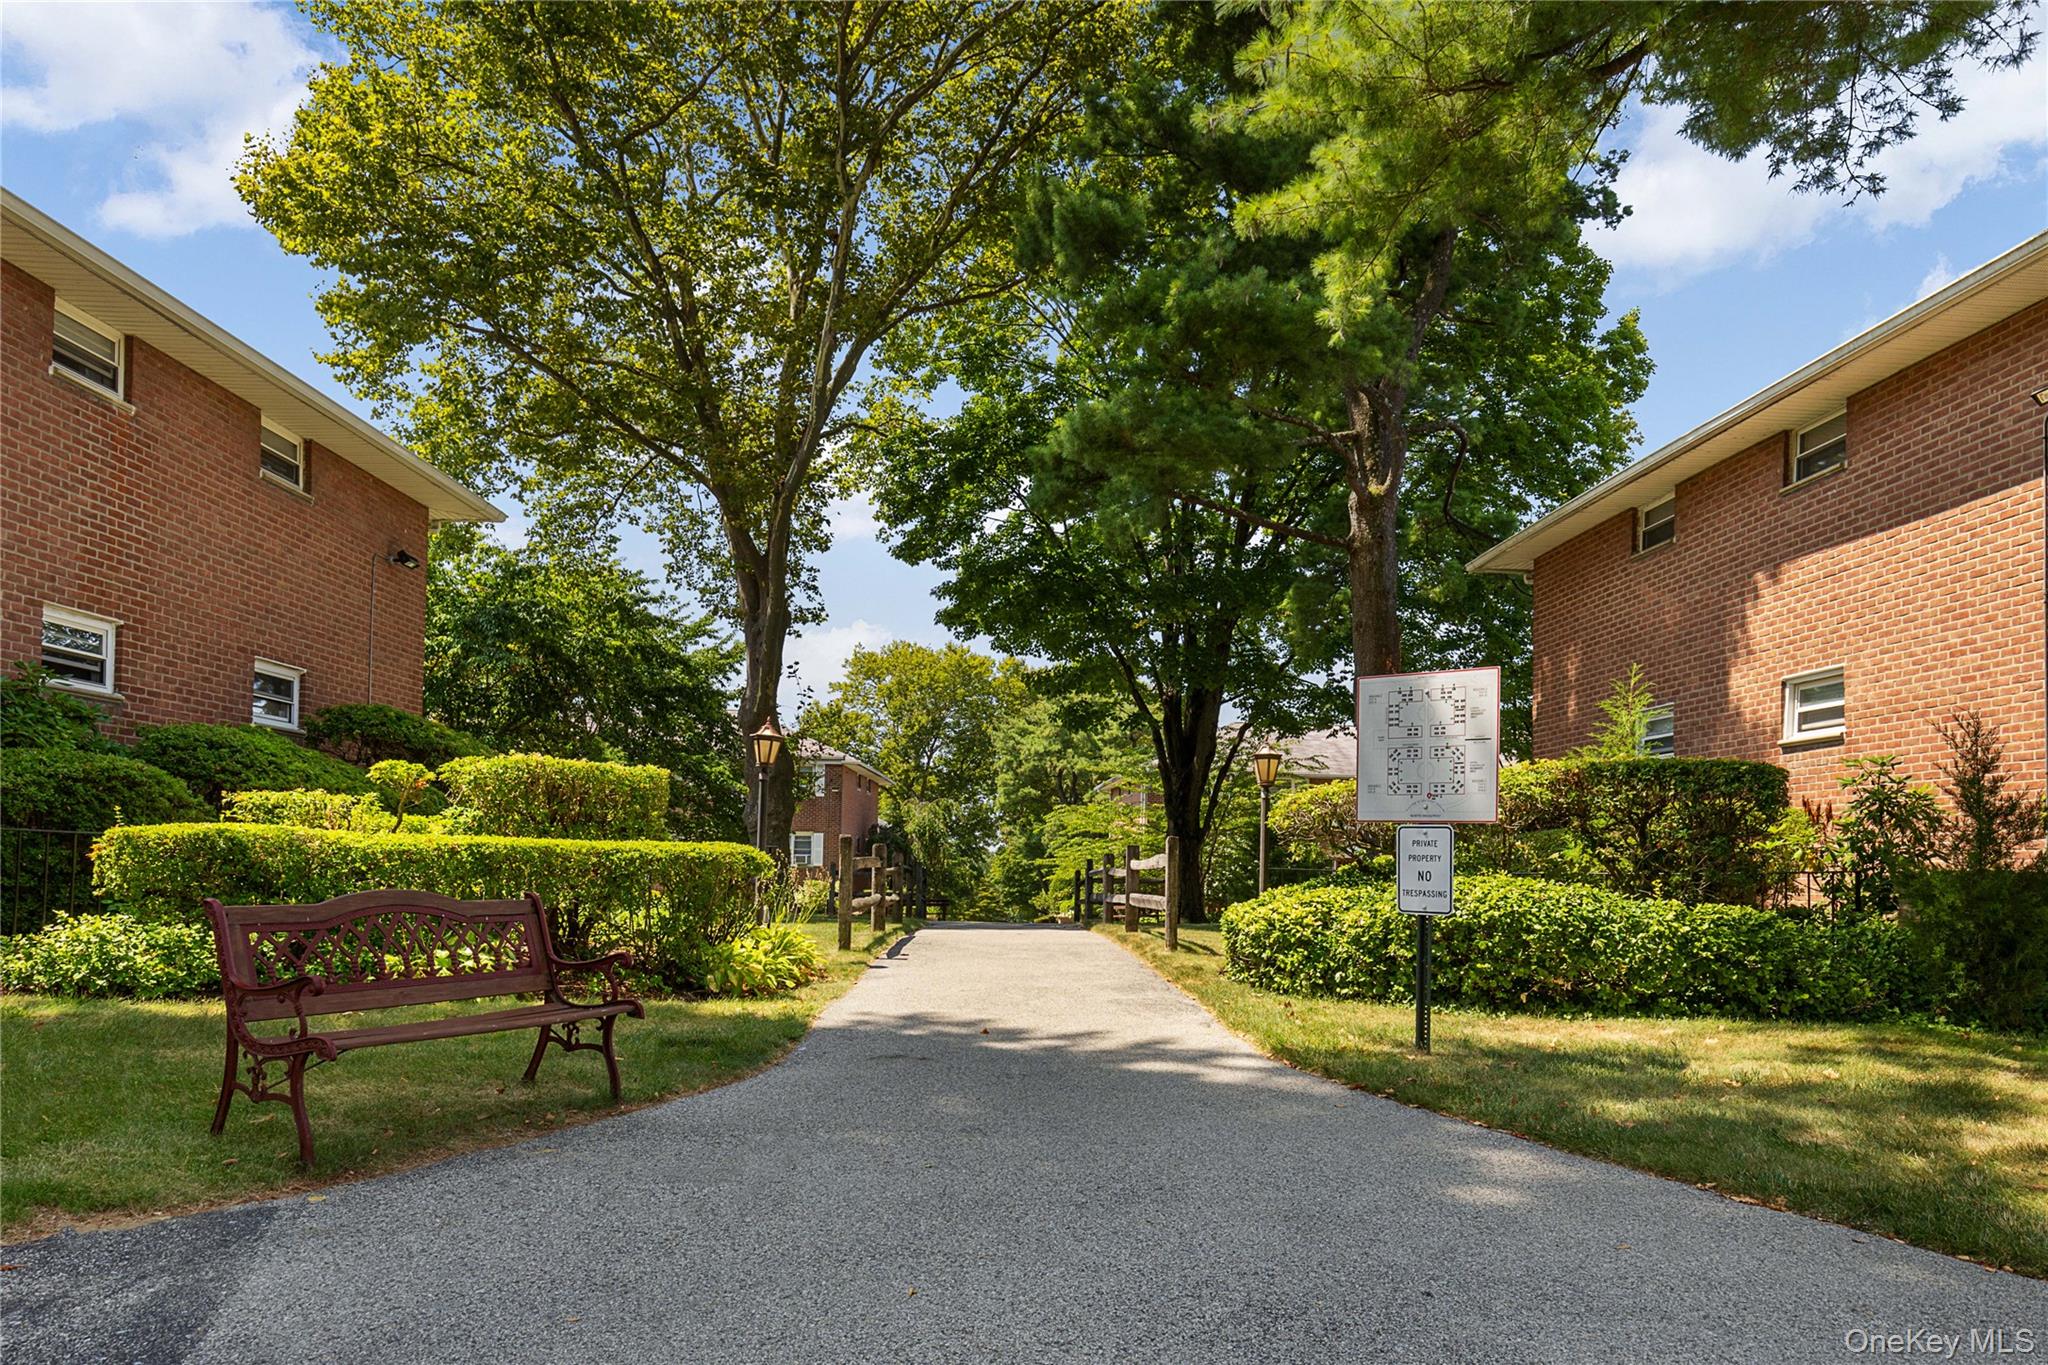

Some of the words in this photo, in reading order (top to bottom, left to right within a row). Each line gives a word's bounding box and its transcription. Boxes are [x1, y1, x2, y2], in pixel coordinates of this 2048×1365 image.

[1411, 839, 1438, 848] PRIVATE
[1408, 854, 1442, 863] PROPERTY
[1417, 870, 1432, 882] NO
[1402, 888, 1448, 899] TRESPASSING
